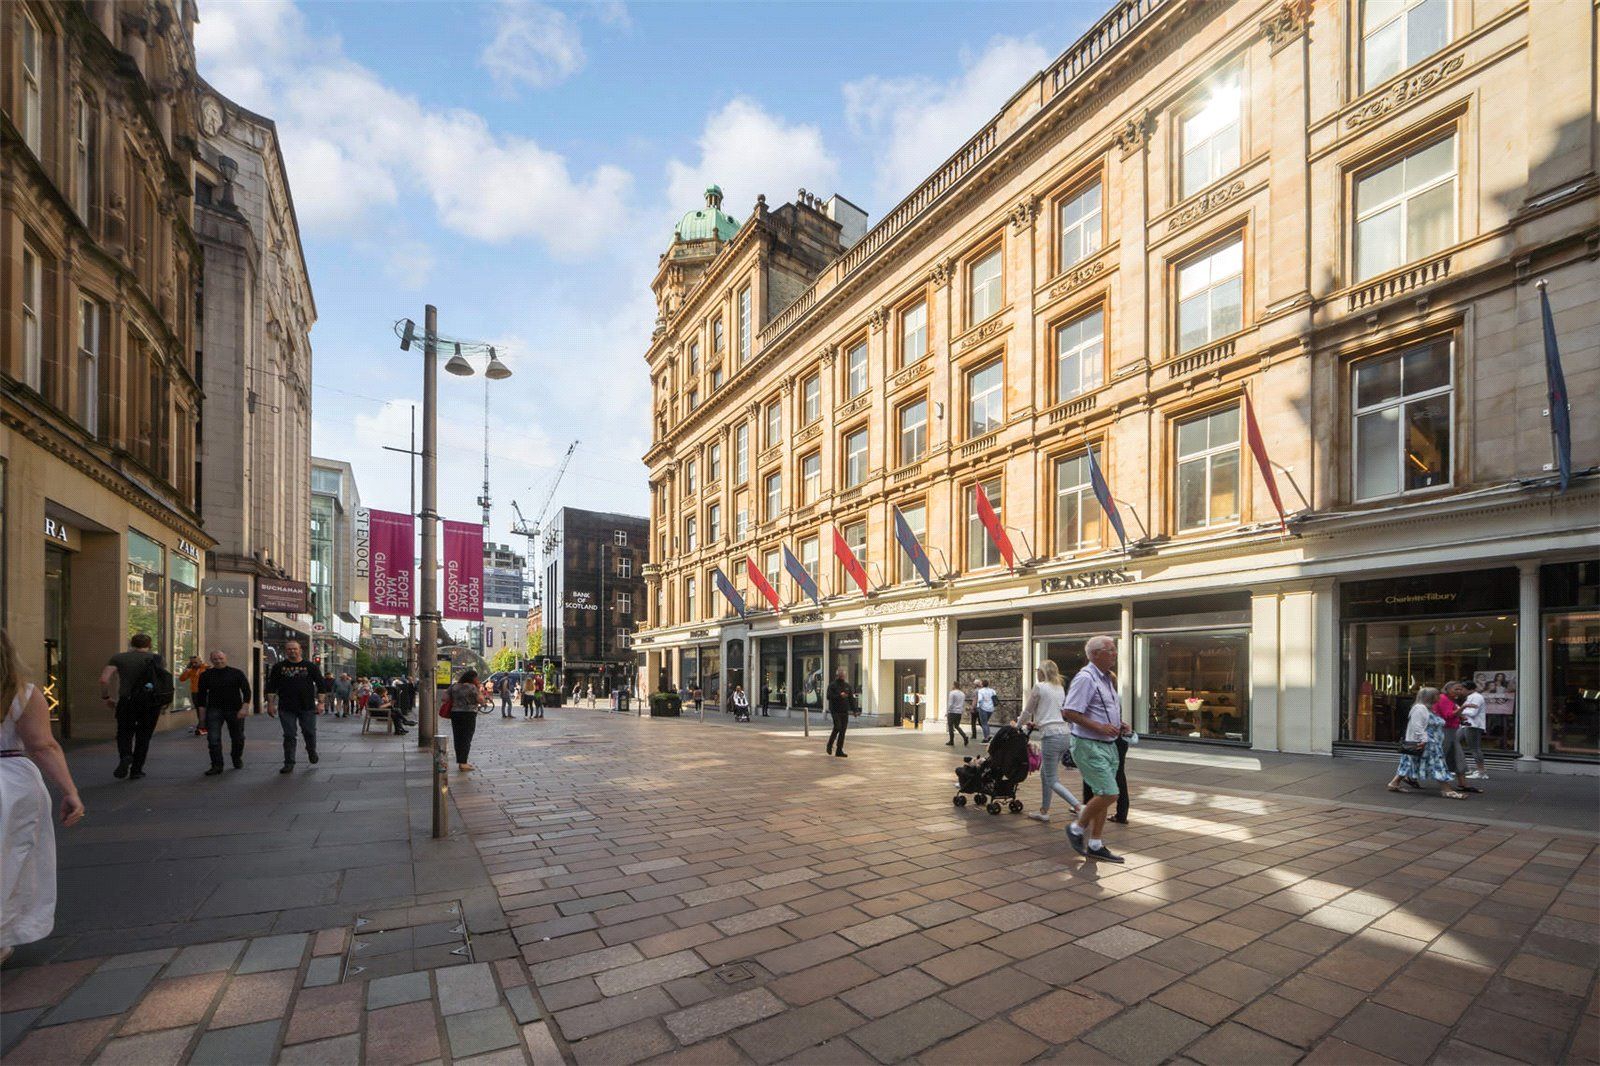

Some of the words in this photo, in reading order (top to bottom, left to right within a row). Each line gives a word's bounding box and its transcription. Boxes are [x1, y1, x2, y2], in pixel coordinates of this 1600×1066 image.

[45, 517, 68, 542] RA
[356, 510, 369, 527] ST
[179, 540, 200, 560] ZARA
[356, 529, 369, 578] ENOCH
[204, 586, 246, 595] ZARA
[261, 584, 303, 594] BUCHANAN
[375, 552, 386, 606] GLASGOW
[386, 576, 397, 607] MAKE
[397, 569, 409, 608] PEOPLE
[448, 560, 458, 612] GLASGOW
[459, 584, 468, 613] MAKE
[469, 577, 479, 613] PEOPLE
[565, 602, 598, 611] SCOTLAND
